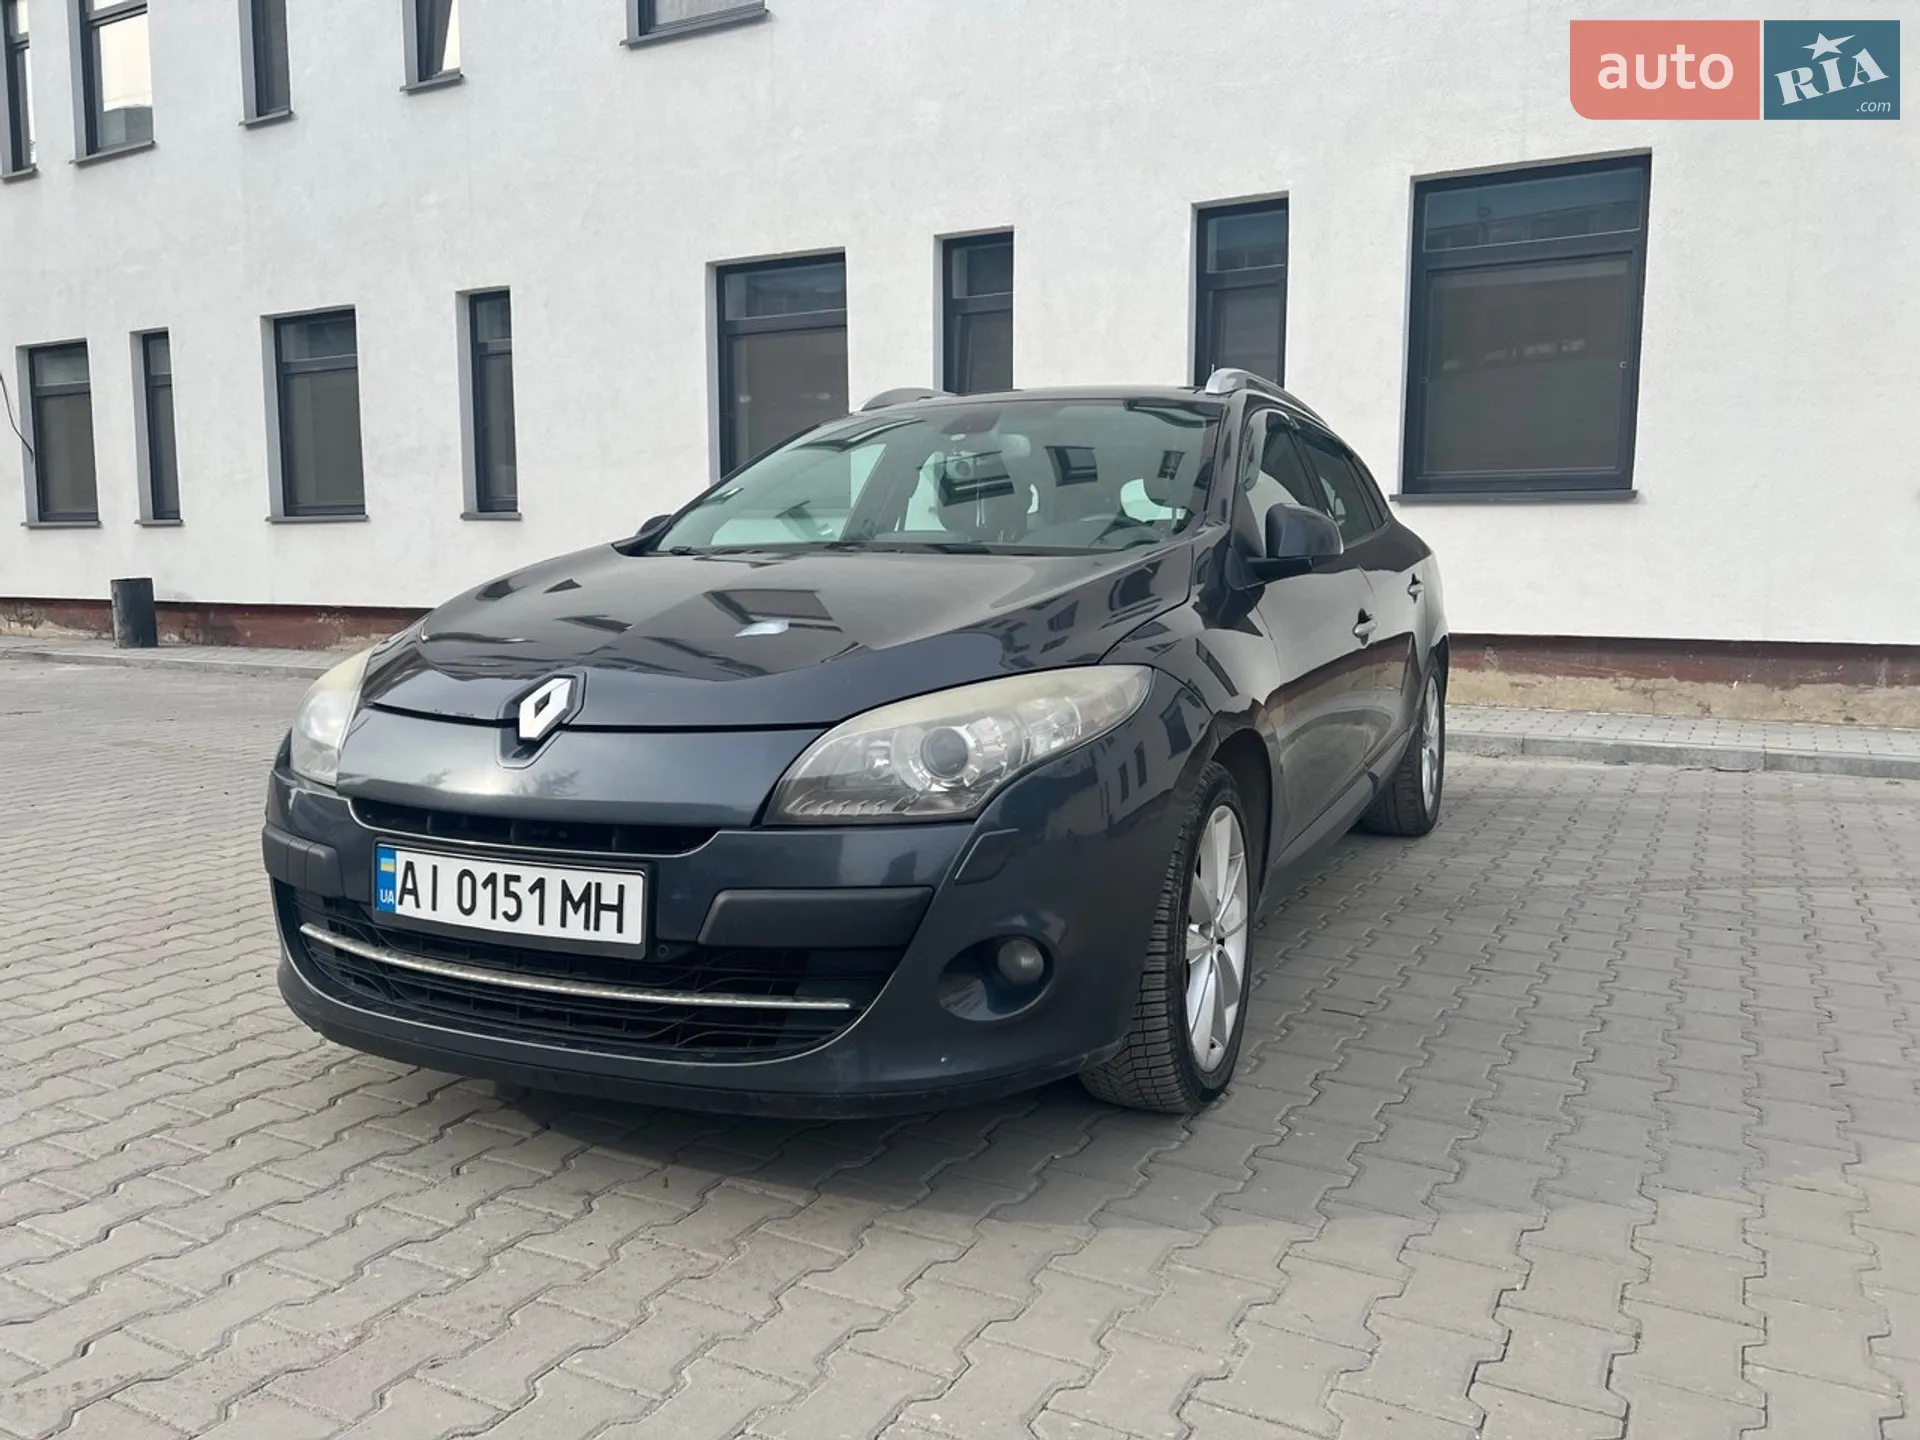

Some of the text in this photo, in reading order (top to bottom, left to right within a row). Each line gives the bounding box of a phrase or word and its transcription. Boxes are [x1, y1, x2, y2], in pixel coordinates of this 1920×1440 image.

[379, 889, 395, 904] UA
[398, 860, 625, 934] AI 0151 MH
